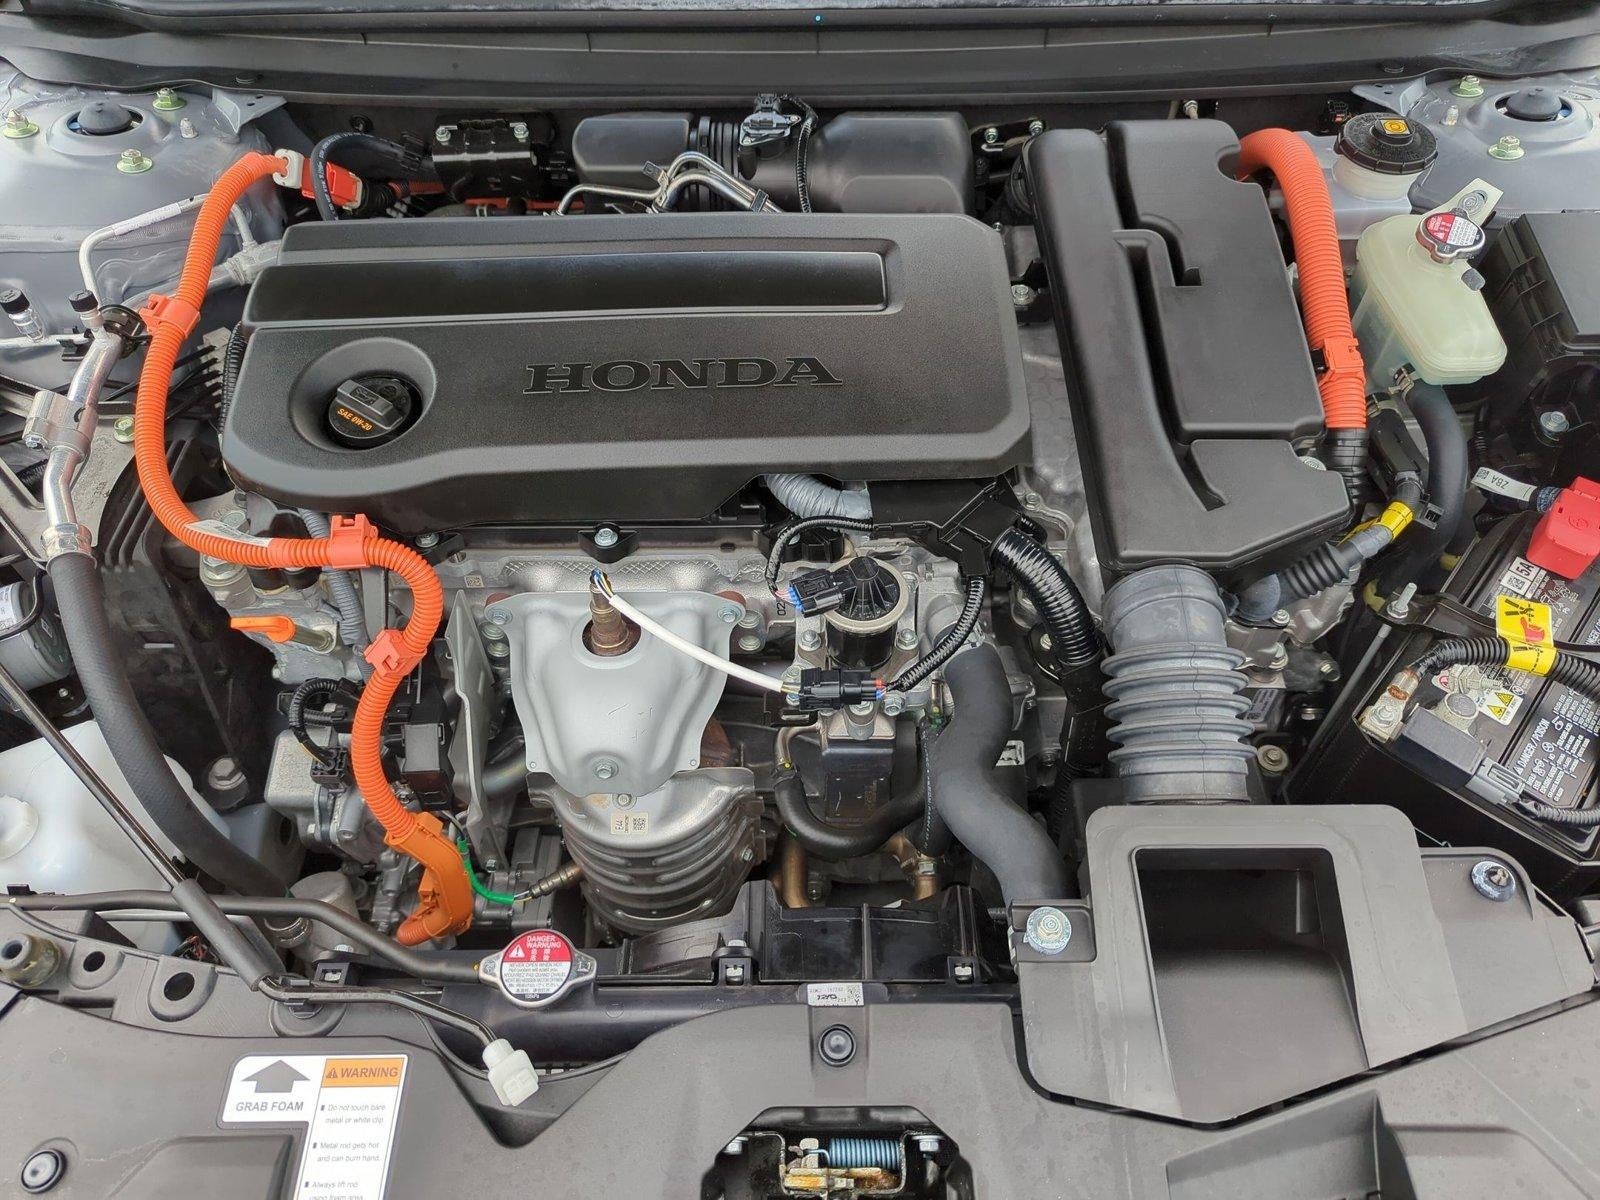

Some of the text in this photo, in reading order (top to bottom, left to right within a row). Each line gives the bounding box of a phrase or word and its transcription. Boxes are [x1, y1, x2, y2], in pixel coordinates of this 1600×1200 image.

[523, 356, 842, 394] HONDA
[337, 408, 373, 431] SAE 0W-20
[1491, 475, 1509, 489] ZBA
[1516, 562, 1534, 576] 5A
[340, 1067, 398, 1078] WARNING
[236, 1101, 304, 1112] GRAB FOAM
[312, 1181, 336, 1189] Always
[337, 1180, 346, 1188] lift
